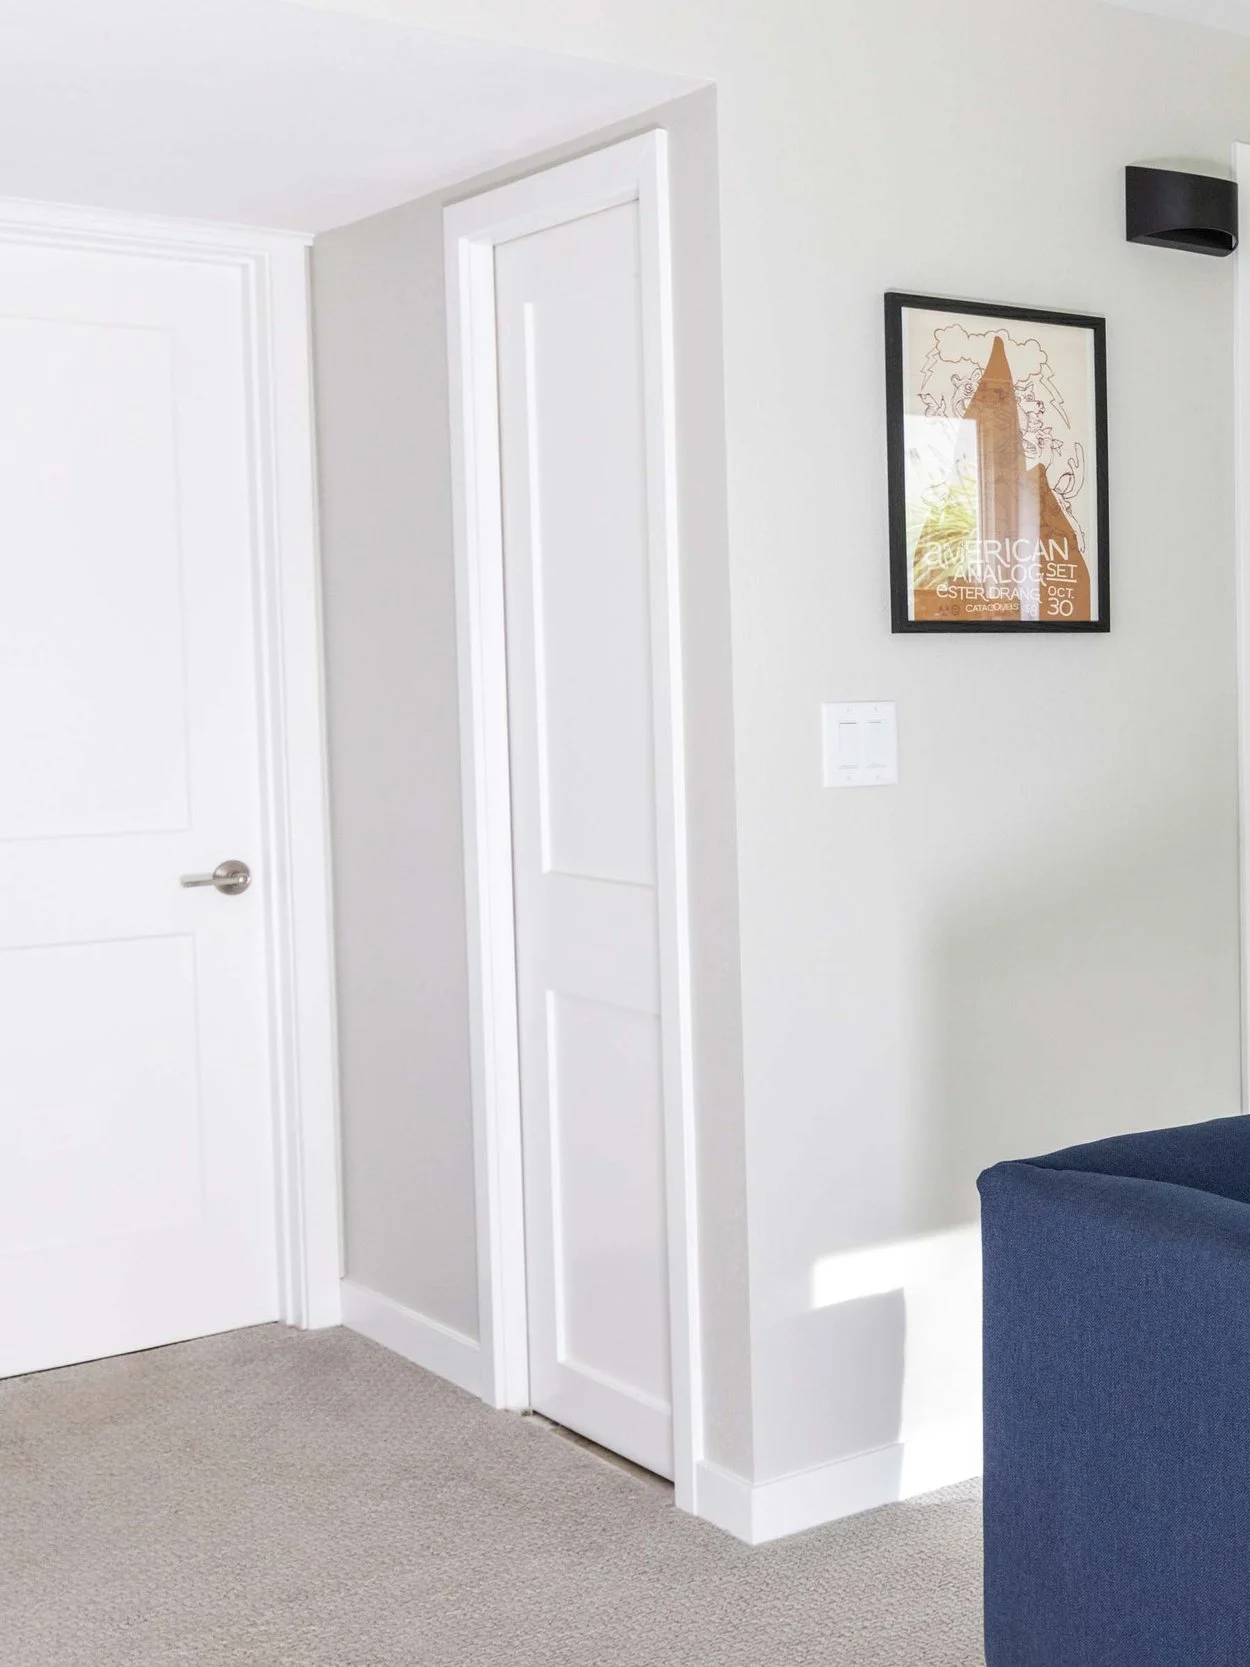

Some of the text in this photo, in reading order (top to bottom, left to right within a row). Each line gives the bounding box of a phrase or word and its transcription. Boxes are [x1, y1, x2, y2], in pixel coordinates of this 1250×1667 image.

[954, 562, 1078, 586] ANALOG SET
[1047, 586, 1075, 599] OCT.
[1047, 597, 1074, 616] 30
